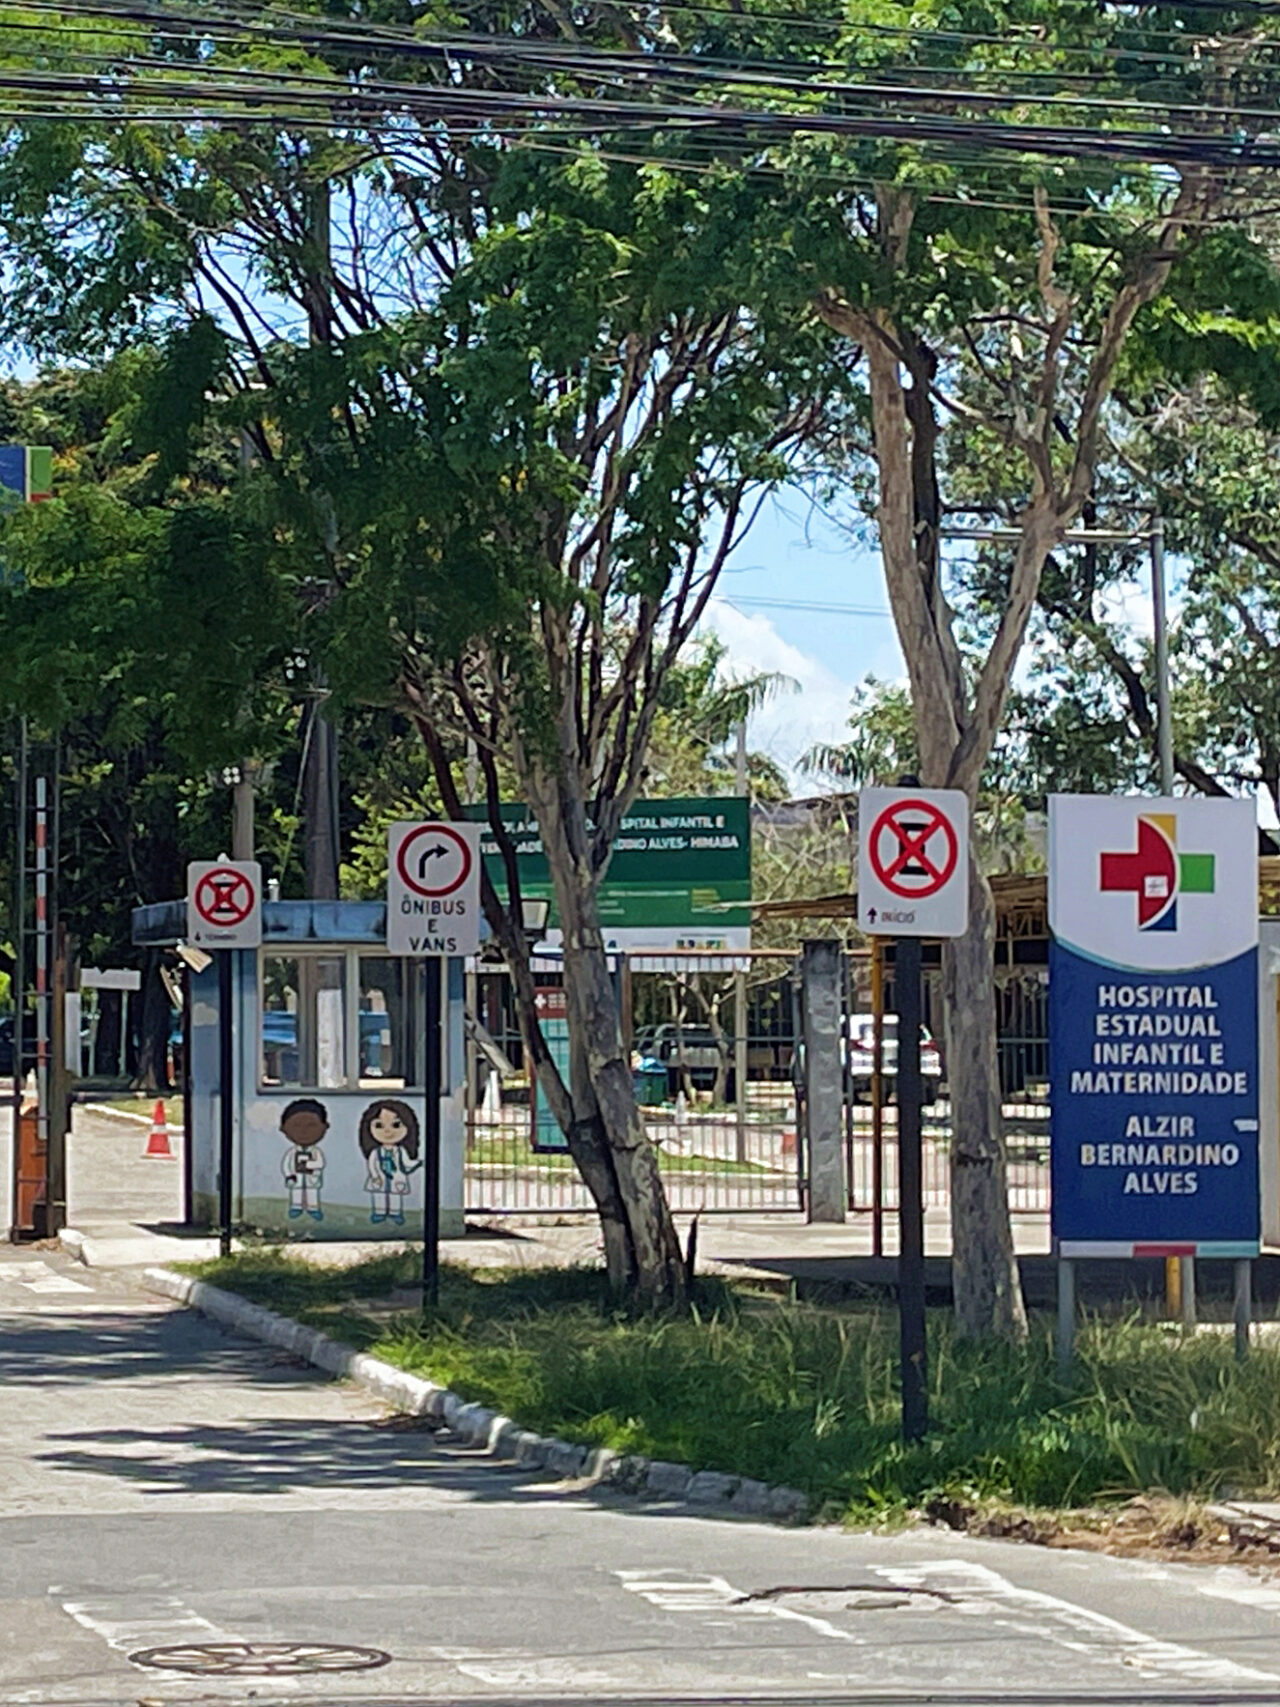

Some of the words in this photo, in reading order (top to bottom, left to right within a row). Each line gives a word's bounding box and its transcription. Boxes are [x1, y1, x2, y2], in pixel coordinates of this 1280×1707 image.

[401, 894, 466, 916] ÔNIBUS
[428, 918, 438, 934] E
[409, 936, 457, 953] VANS
[1098, 985, 1218, 1008] HOSPITAL
[1096, 1014, 1222, 1037] ESTADUAL
[1094, 1042, 1205, 1065] INFANTIL
[1210, 1043, 1224, 1065] E
[1071, 1071, 1248, 1094] MATERNIDADE
[1125, 1115, 1195, 1138] ALZIR
[1080, 1143, 1240, 1166] BERNARDINO
[1123, 1171, 1198, 1194] ALVES
